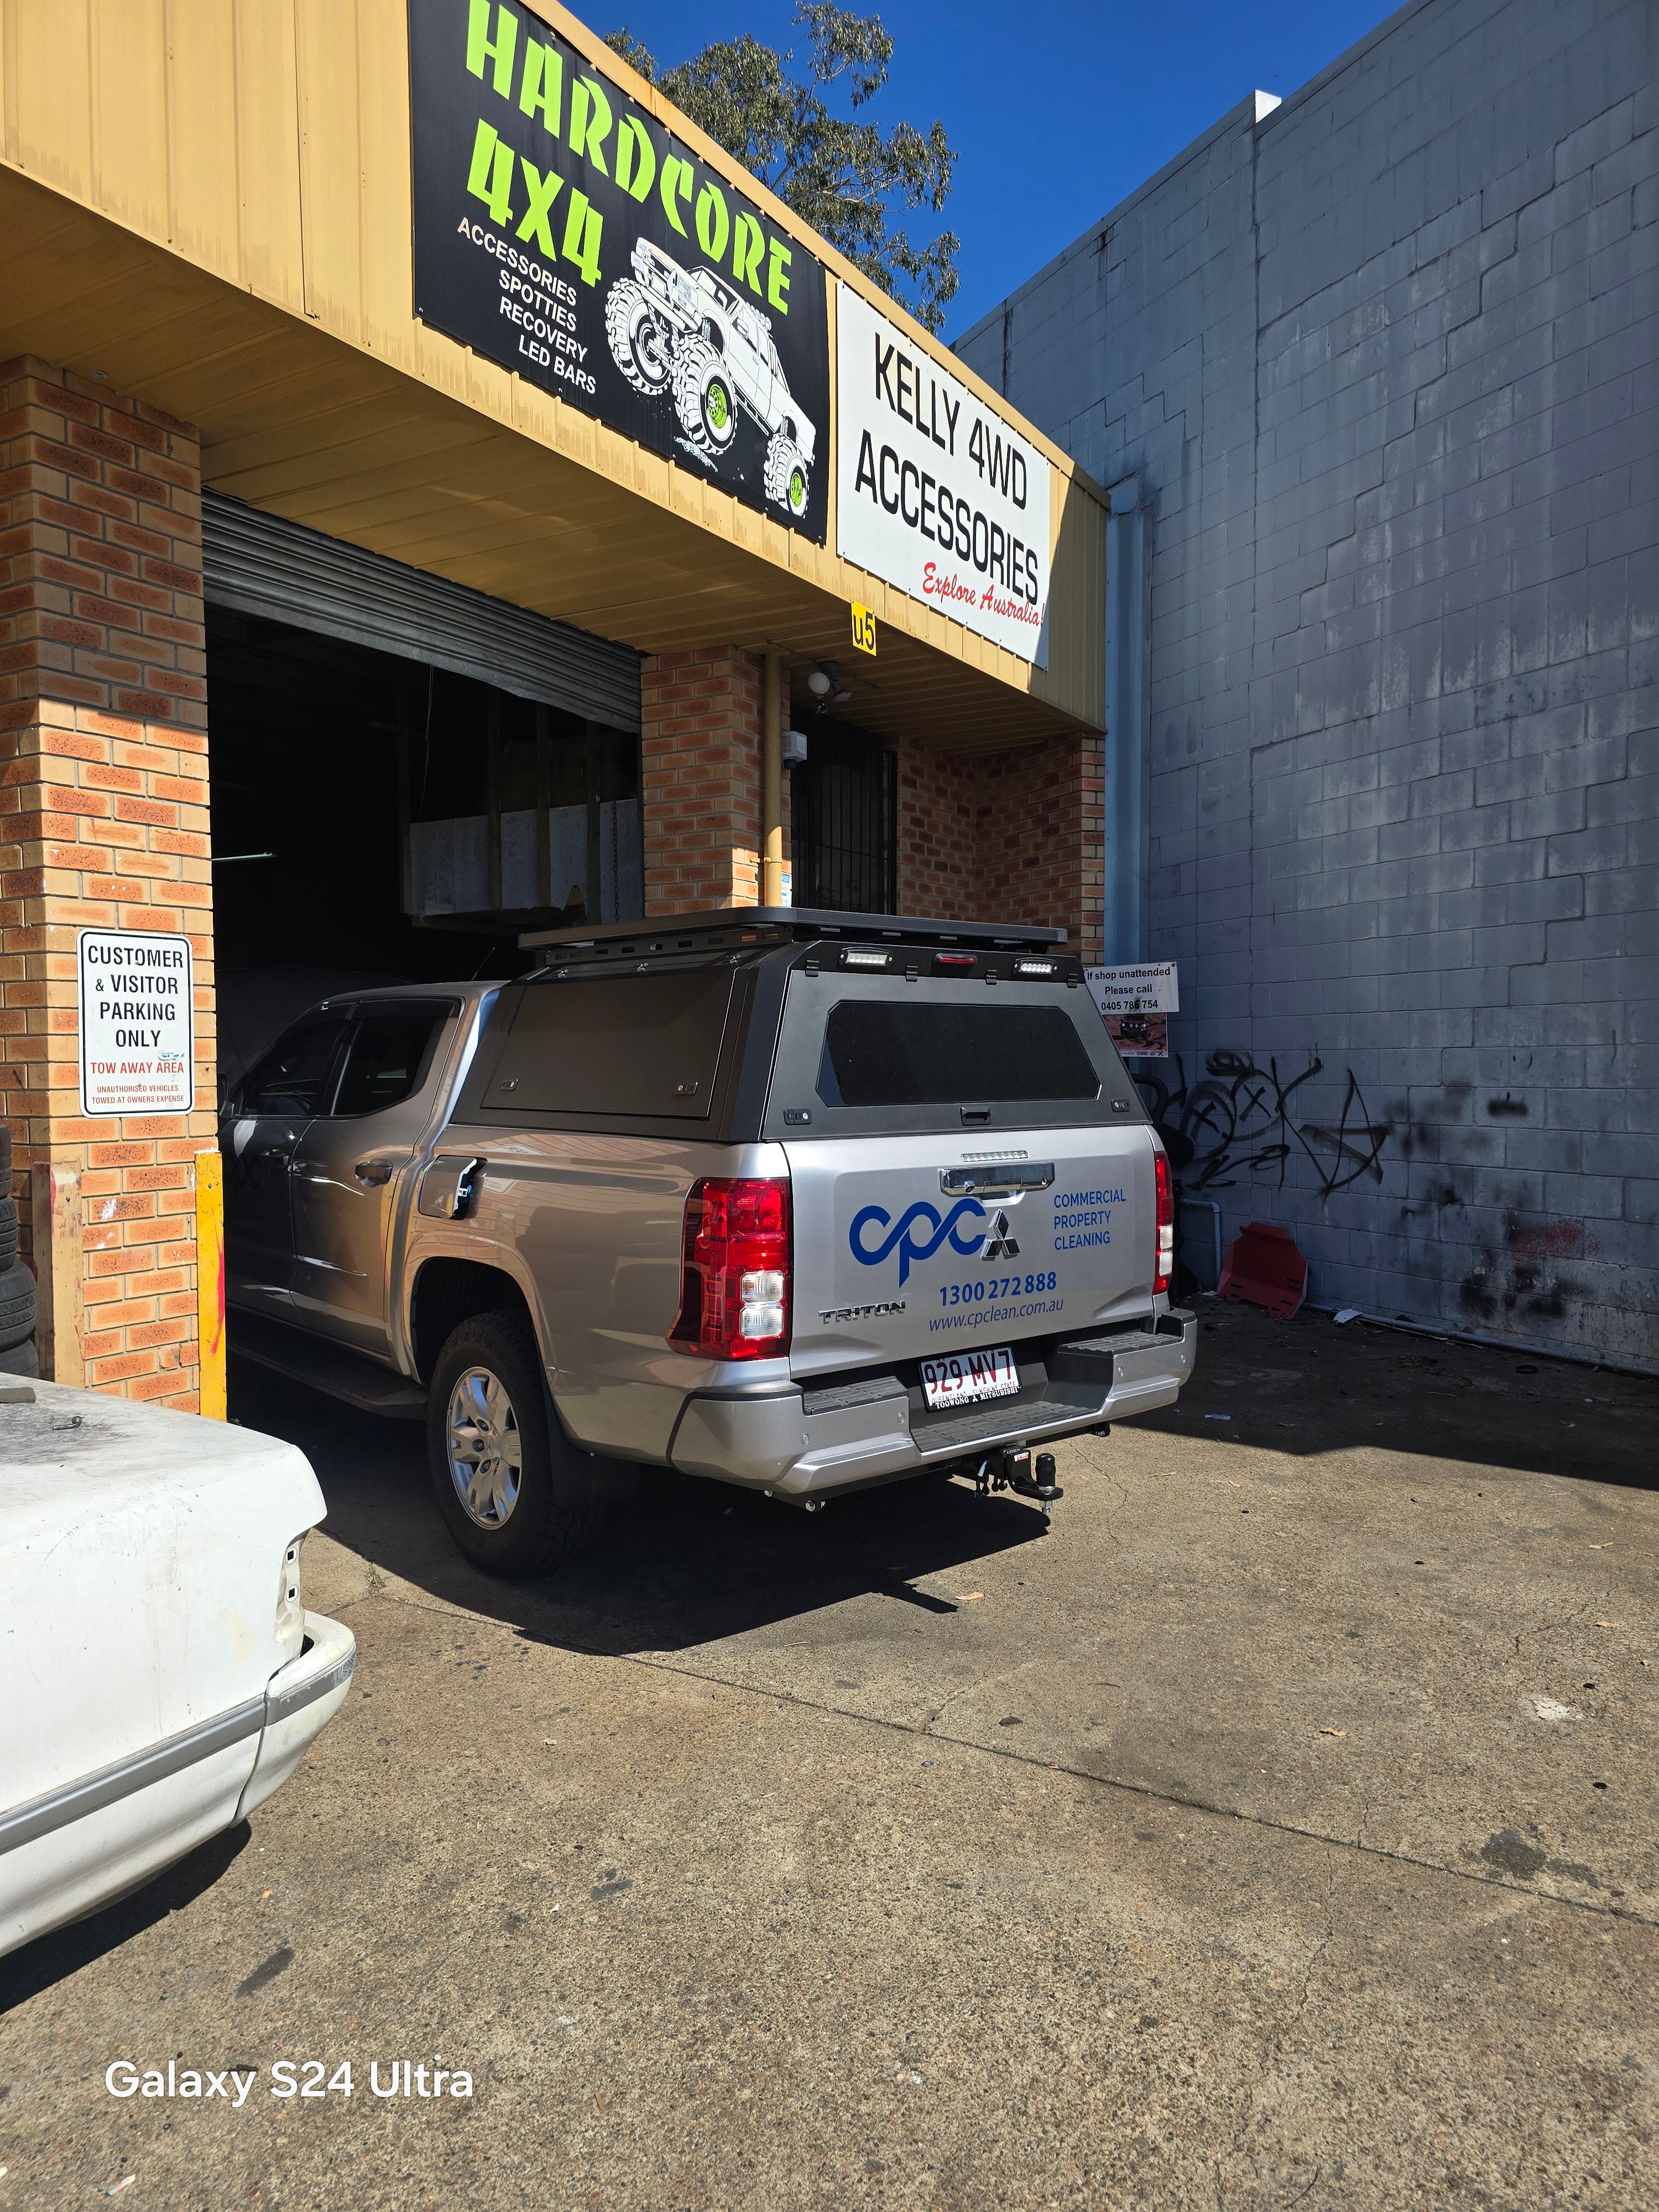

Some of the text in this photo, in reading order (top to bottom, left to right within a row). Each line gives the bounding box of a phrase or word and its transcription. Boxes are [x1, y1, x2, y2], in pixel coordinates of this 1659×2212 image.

[466, 0, 792, 315] HARDCORE
[457, 217, 577, 306] ACCESSORIES
[499, 270, 577, 331] SPOTTIES
[499, 296, 588, 362] RECOVERY
[519, 335, 596, 394] LED BARS
[875, 332, 1026, 510] KELLY 4WD
[855, 429, 1038, 605] ACCESSORIES
[922, 562, 1044, 628] Explore Australia!
[88, 945, 184, 968] CUSTOMER
[96, 974, 178, 994] & VISITOR
[1087, 967, 1171, 981] If shop unattended
[1105, 984, 1152, 994] Please call
[100, 1001, 175, 1021] PARKING
[1141, 1000, 1158, 1009] 754
[116, 1030, 161, 1047] ONLY
[91, 1062, 184, 1074] TOW AWAY AREA
[97, 1085, 147, 1093] UNAUTHORISED
[1053, 1188, 1126, 1208] COMMERCIAL
[1053, 1210, 1112, 1230] PROPERTY
[849, 1198, 986, 1288] cpc
[1054, 1231, 1110, 1250] CLEANING
[940, 1271, 1057, 1306] 1300 272 888
[818, 1300, 906, 1318] TRITON
[929, 1298, 1063, 1332] www.cpclean.com.au
[935, 1386, 1019, 1409] TOOWONG MITSUBISHI
